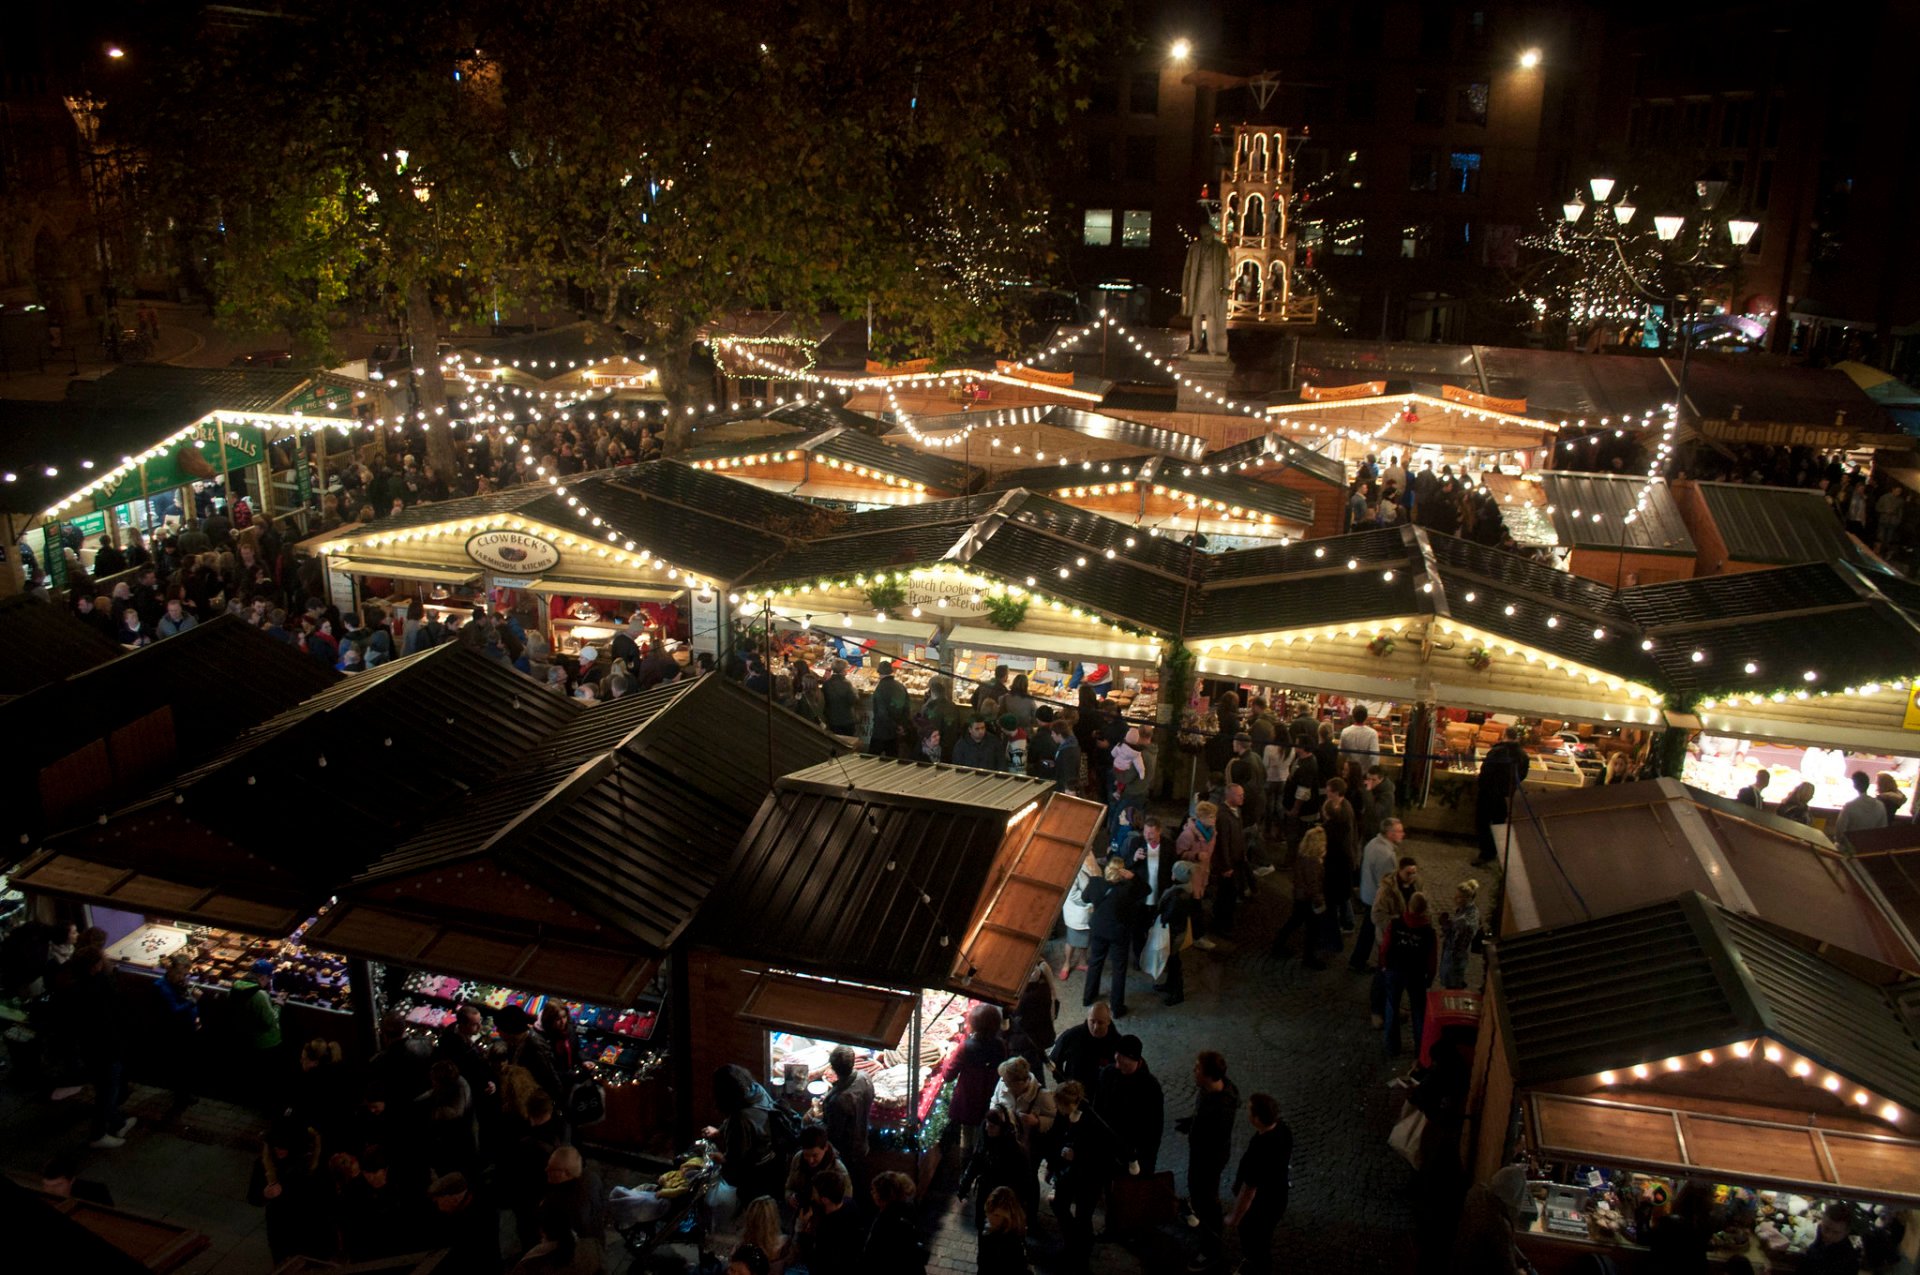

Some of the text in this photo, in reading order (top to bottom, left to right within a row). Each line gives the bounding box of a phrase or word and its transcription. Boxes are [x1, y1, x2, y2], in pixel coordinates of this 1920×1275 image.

[1702, 420, 1850, 447] Windmill House
[477, 534, 548, 554] CLOWBECK'S
[521, 557, 553, 571] KITCHEN
[909, 577, 936, 593] Dutch
